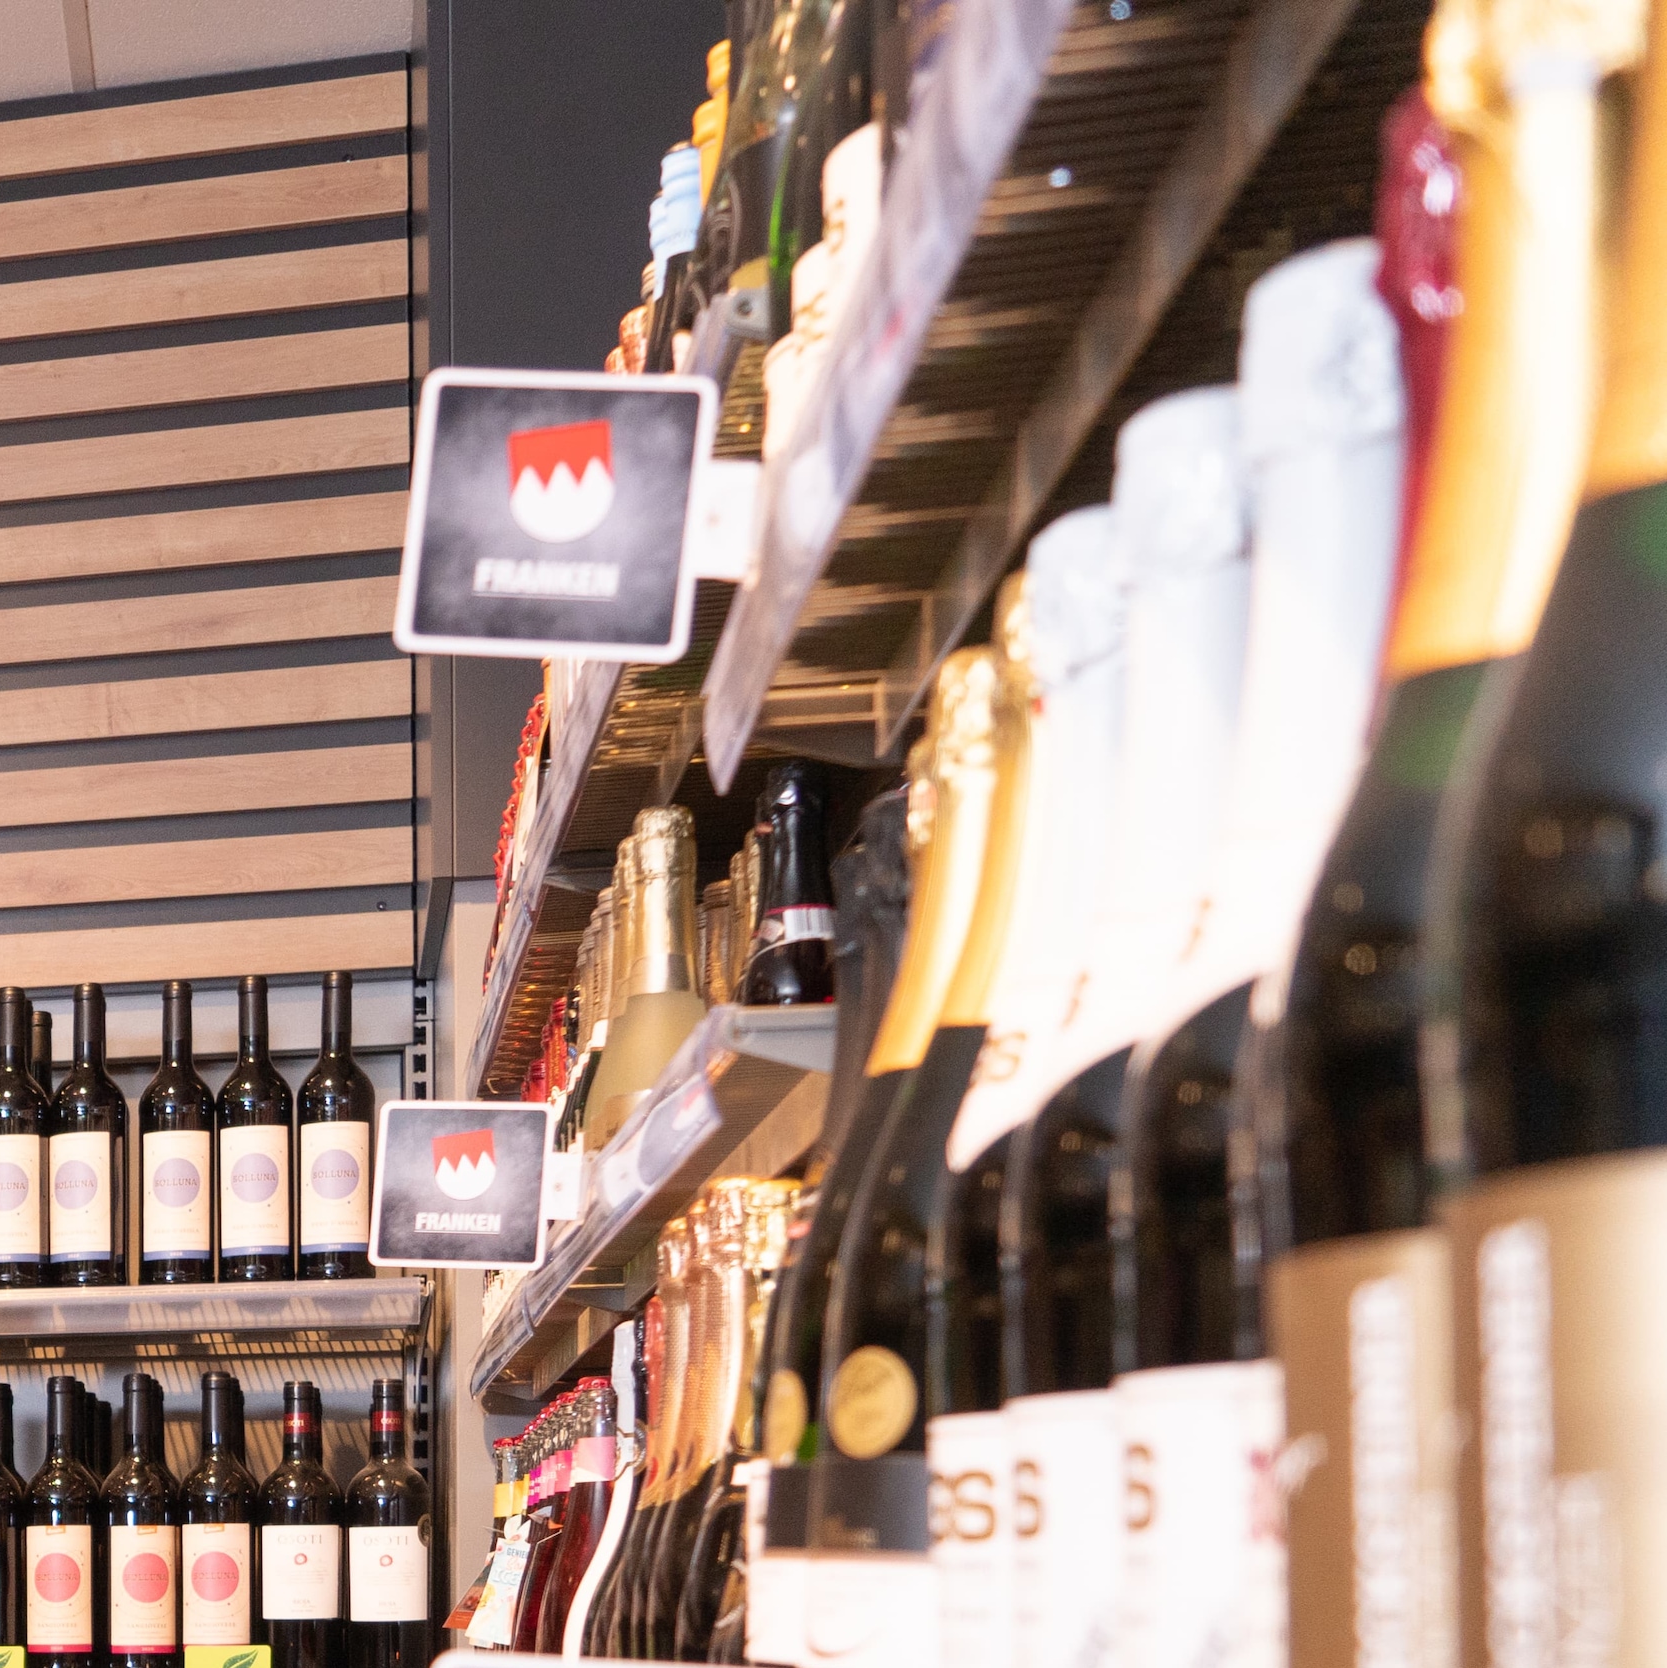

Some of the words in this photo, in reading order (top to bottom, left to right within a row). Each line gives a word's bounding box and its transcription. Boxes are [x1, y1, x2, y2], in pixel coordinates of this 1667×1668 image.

[475, 557, 617, 595] FRANKEN
[232, 1172, 278, 1185] SOLLUNA
[312, 1168, 357, 1182] SOLLUNA
[416, 1212, 501, 1231] FRANKEN
[277, 1533, 323, 1546] OSOTI
